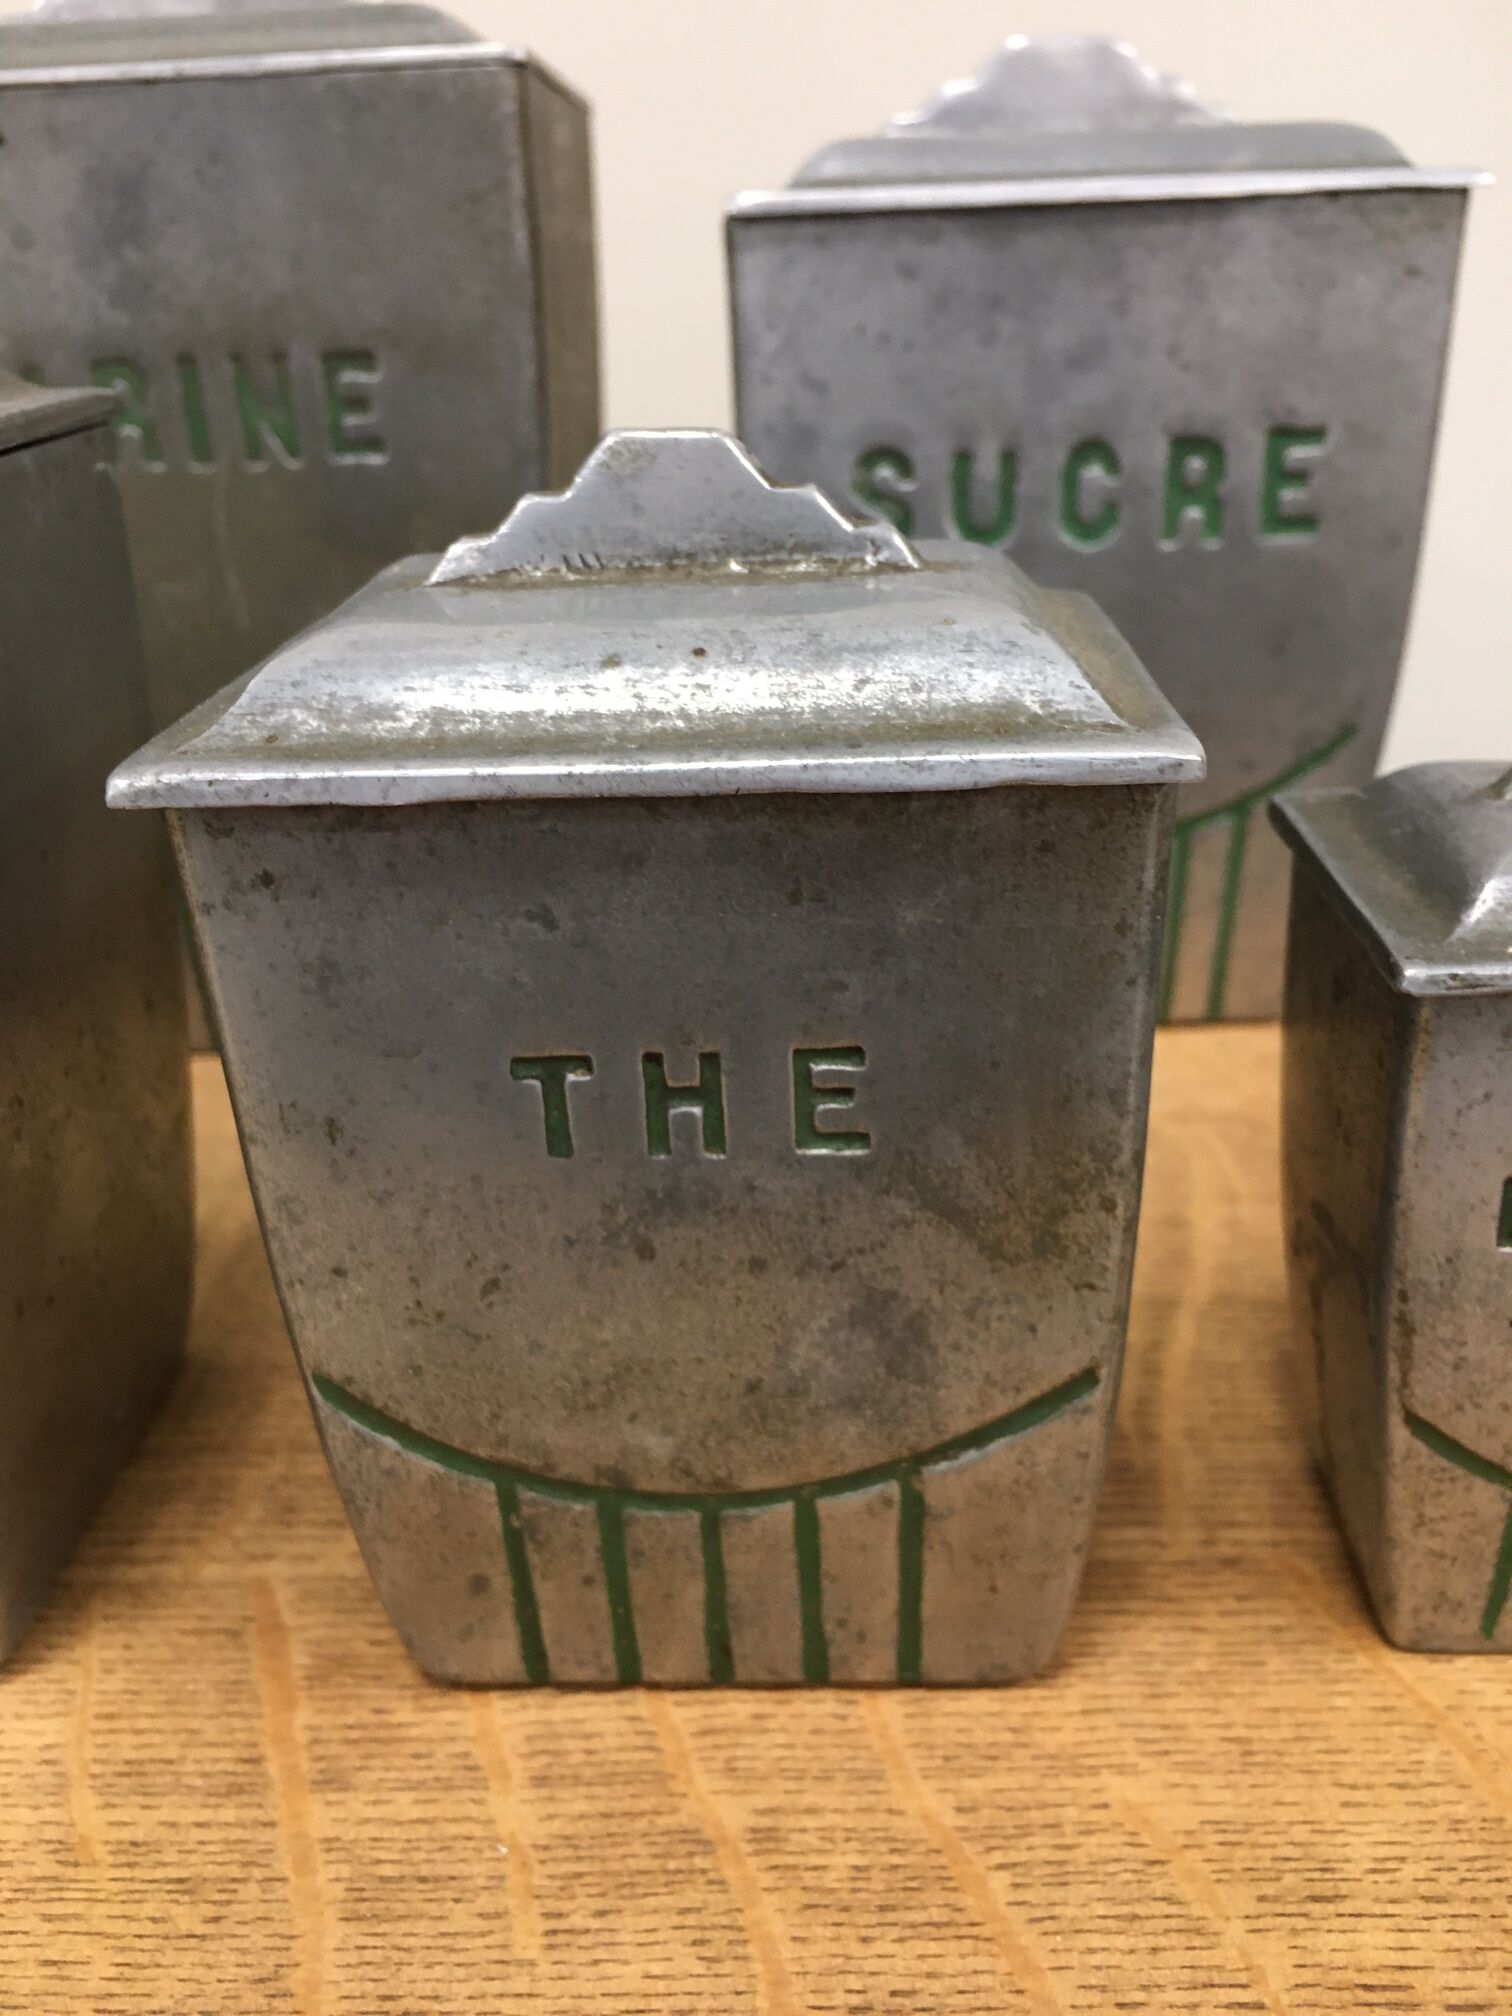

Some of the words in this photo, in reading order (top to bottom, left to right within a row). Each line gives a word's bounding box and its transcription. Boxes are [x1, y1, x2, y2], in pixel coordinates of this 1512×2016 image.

[18, 350, 388, 471] RINE
[852, 424, 1328, 549] SUCRE
[509, 1045, 871, 1158] THE
